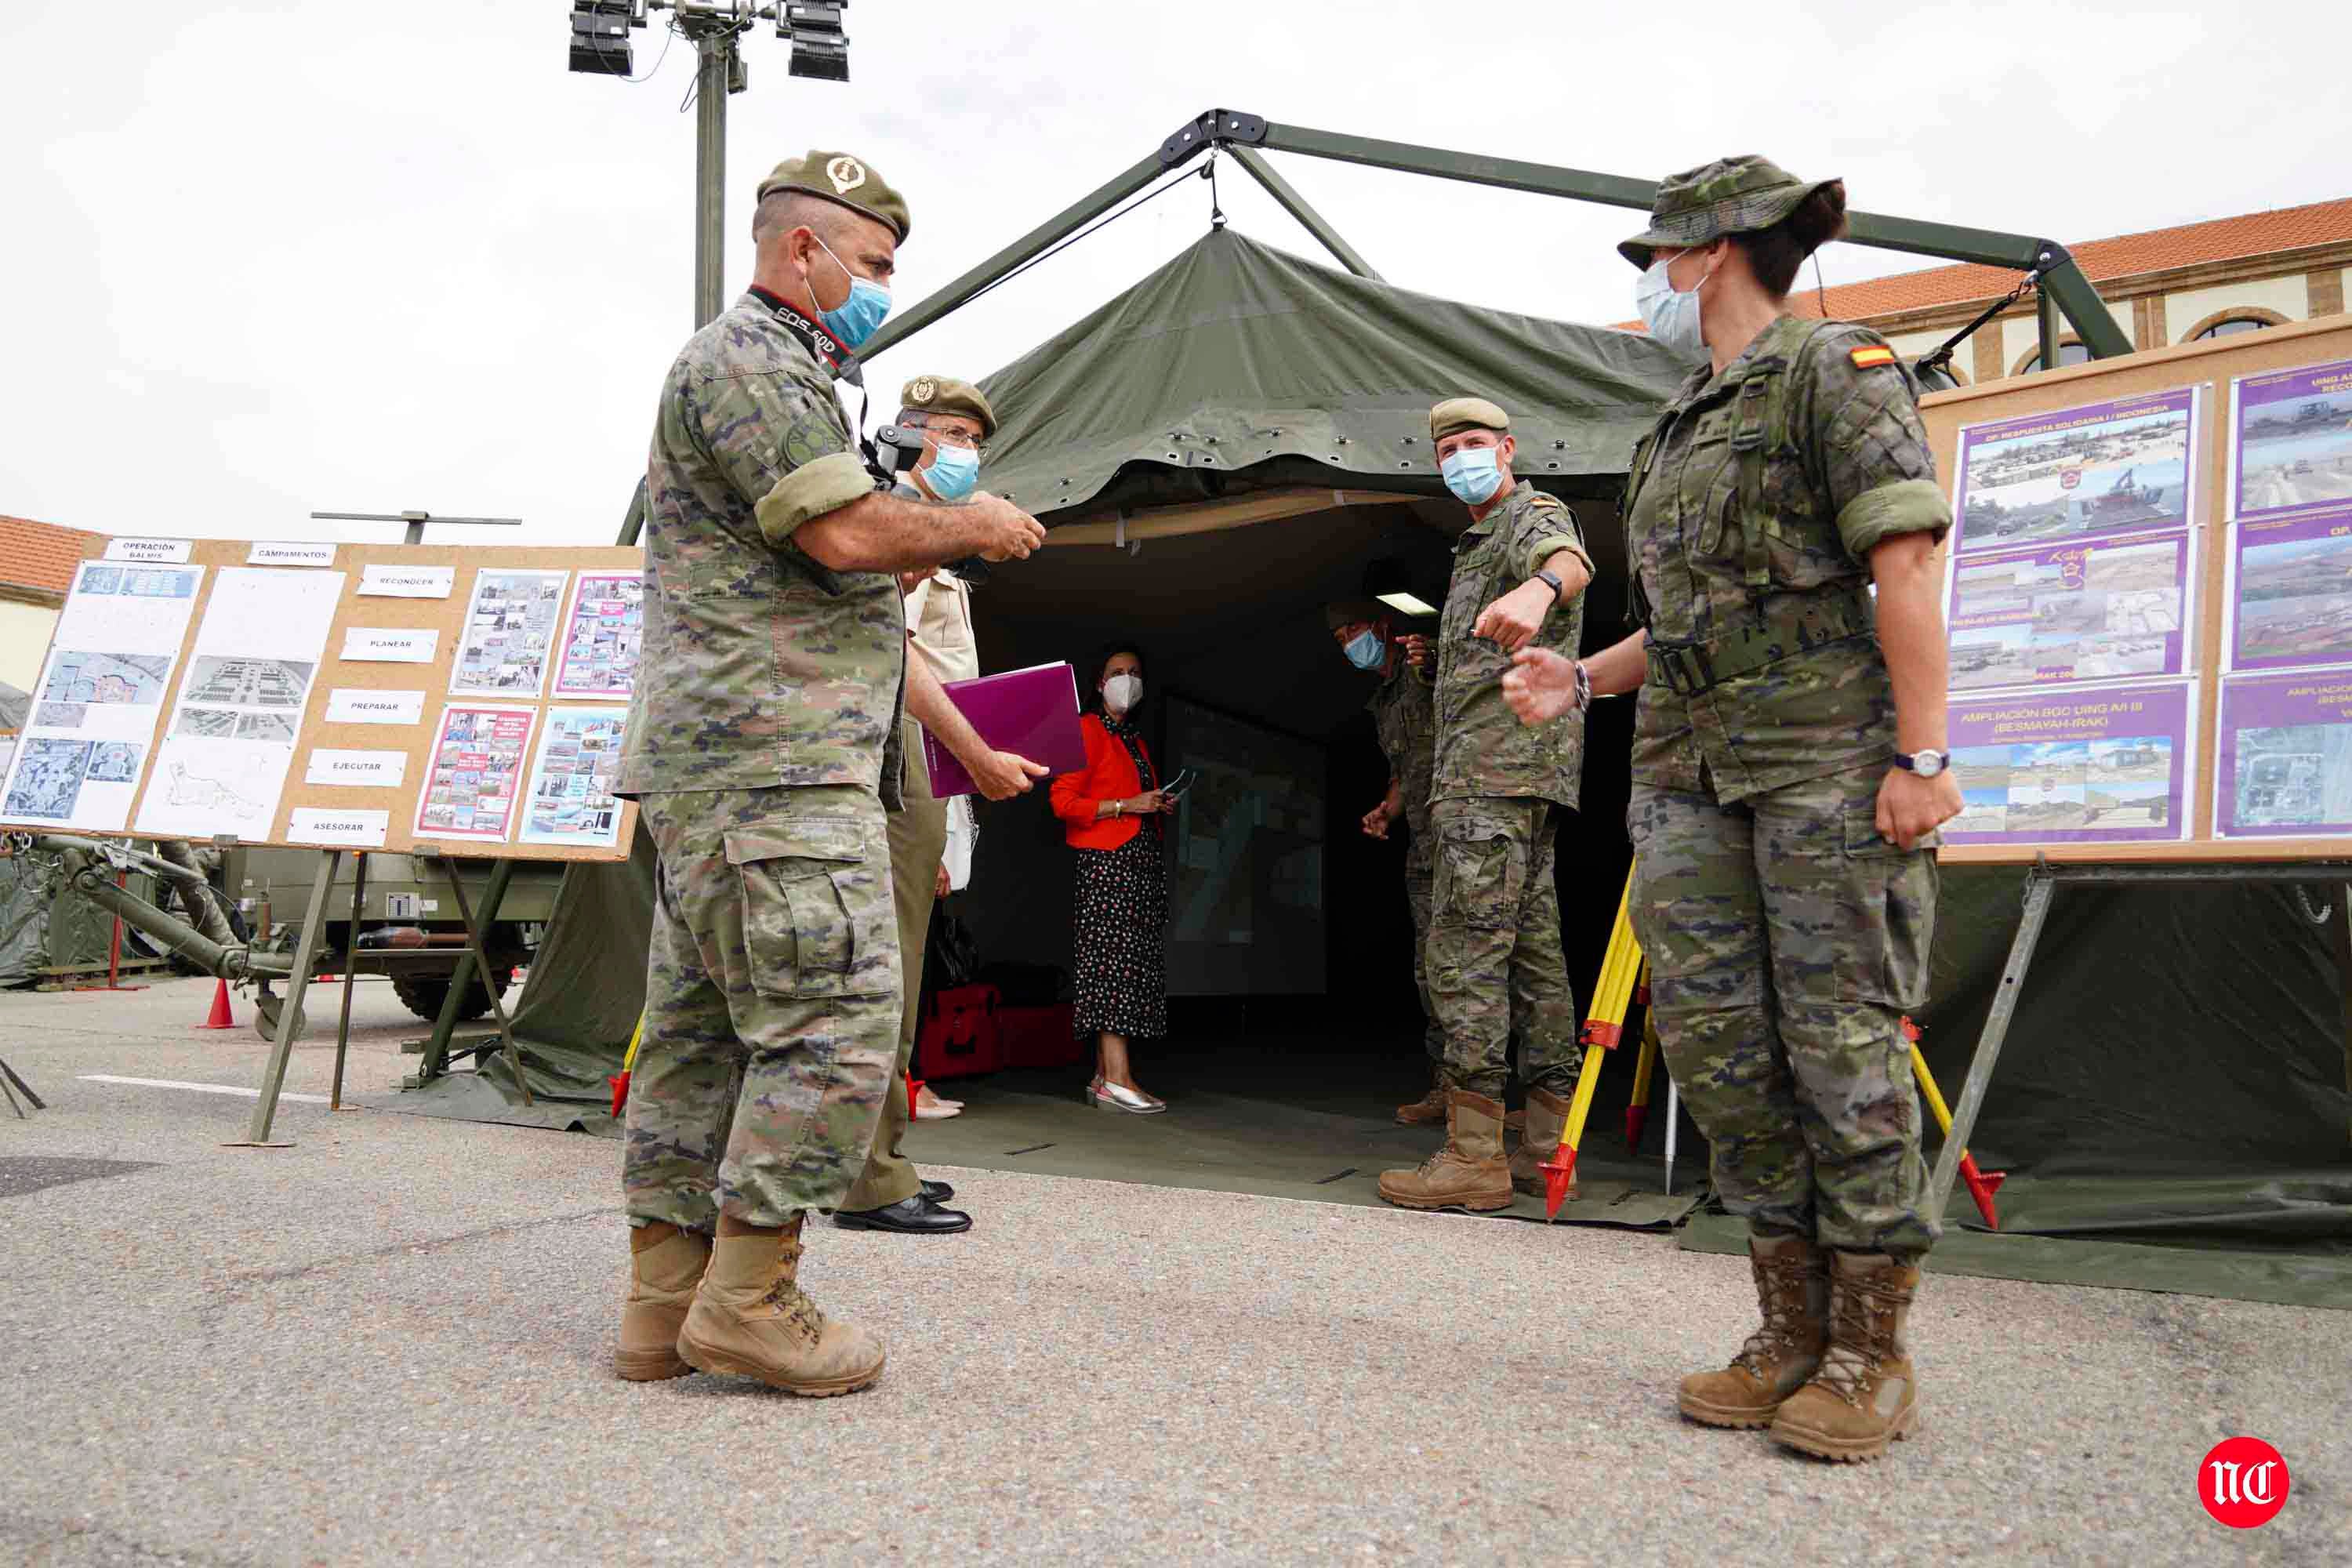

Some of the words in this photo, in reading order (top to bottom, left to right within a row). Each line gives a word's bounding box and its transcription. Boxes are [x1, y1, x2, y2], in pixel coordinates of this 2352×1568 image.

[777, 307, 811, 330] EOS
[812, 330, 836, 353] 60D
[2116, 405, 2170, 420] INDONESIA
[258, 550, 327, 559] CAMPAMENTOS
[332, 762, 382, 771] EJECUTAR
[314, 822, 364, 831] ASESORAR
